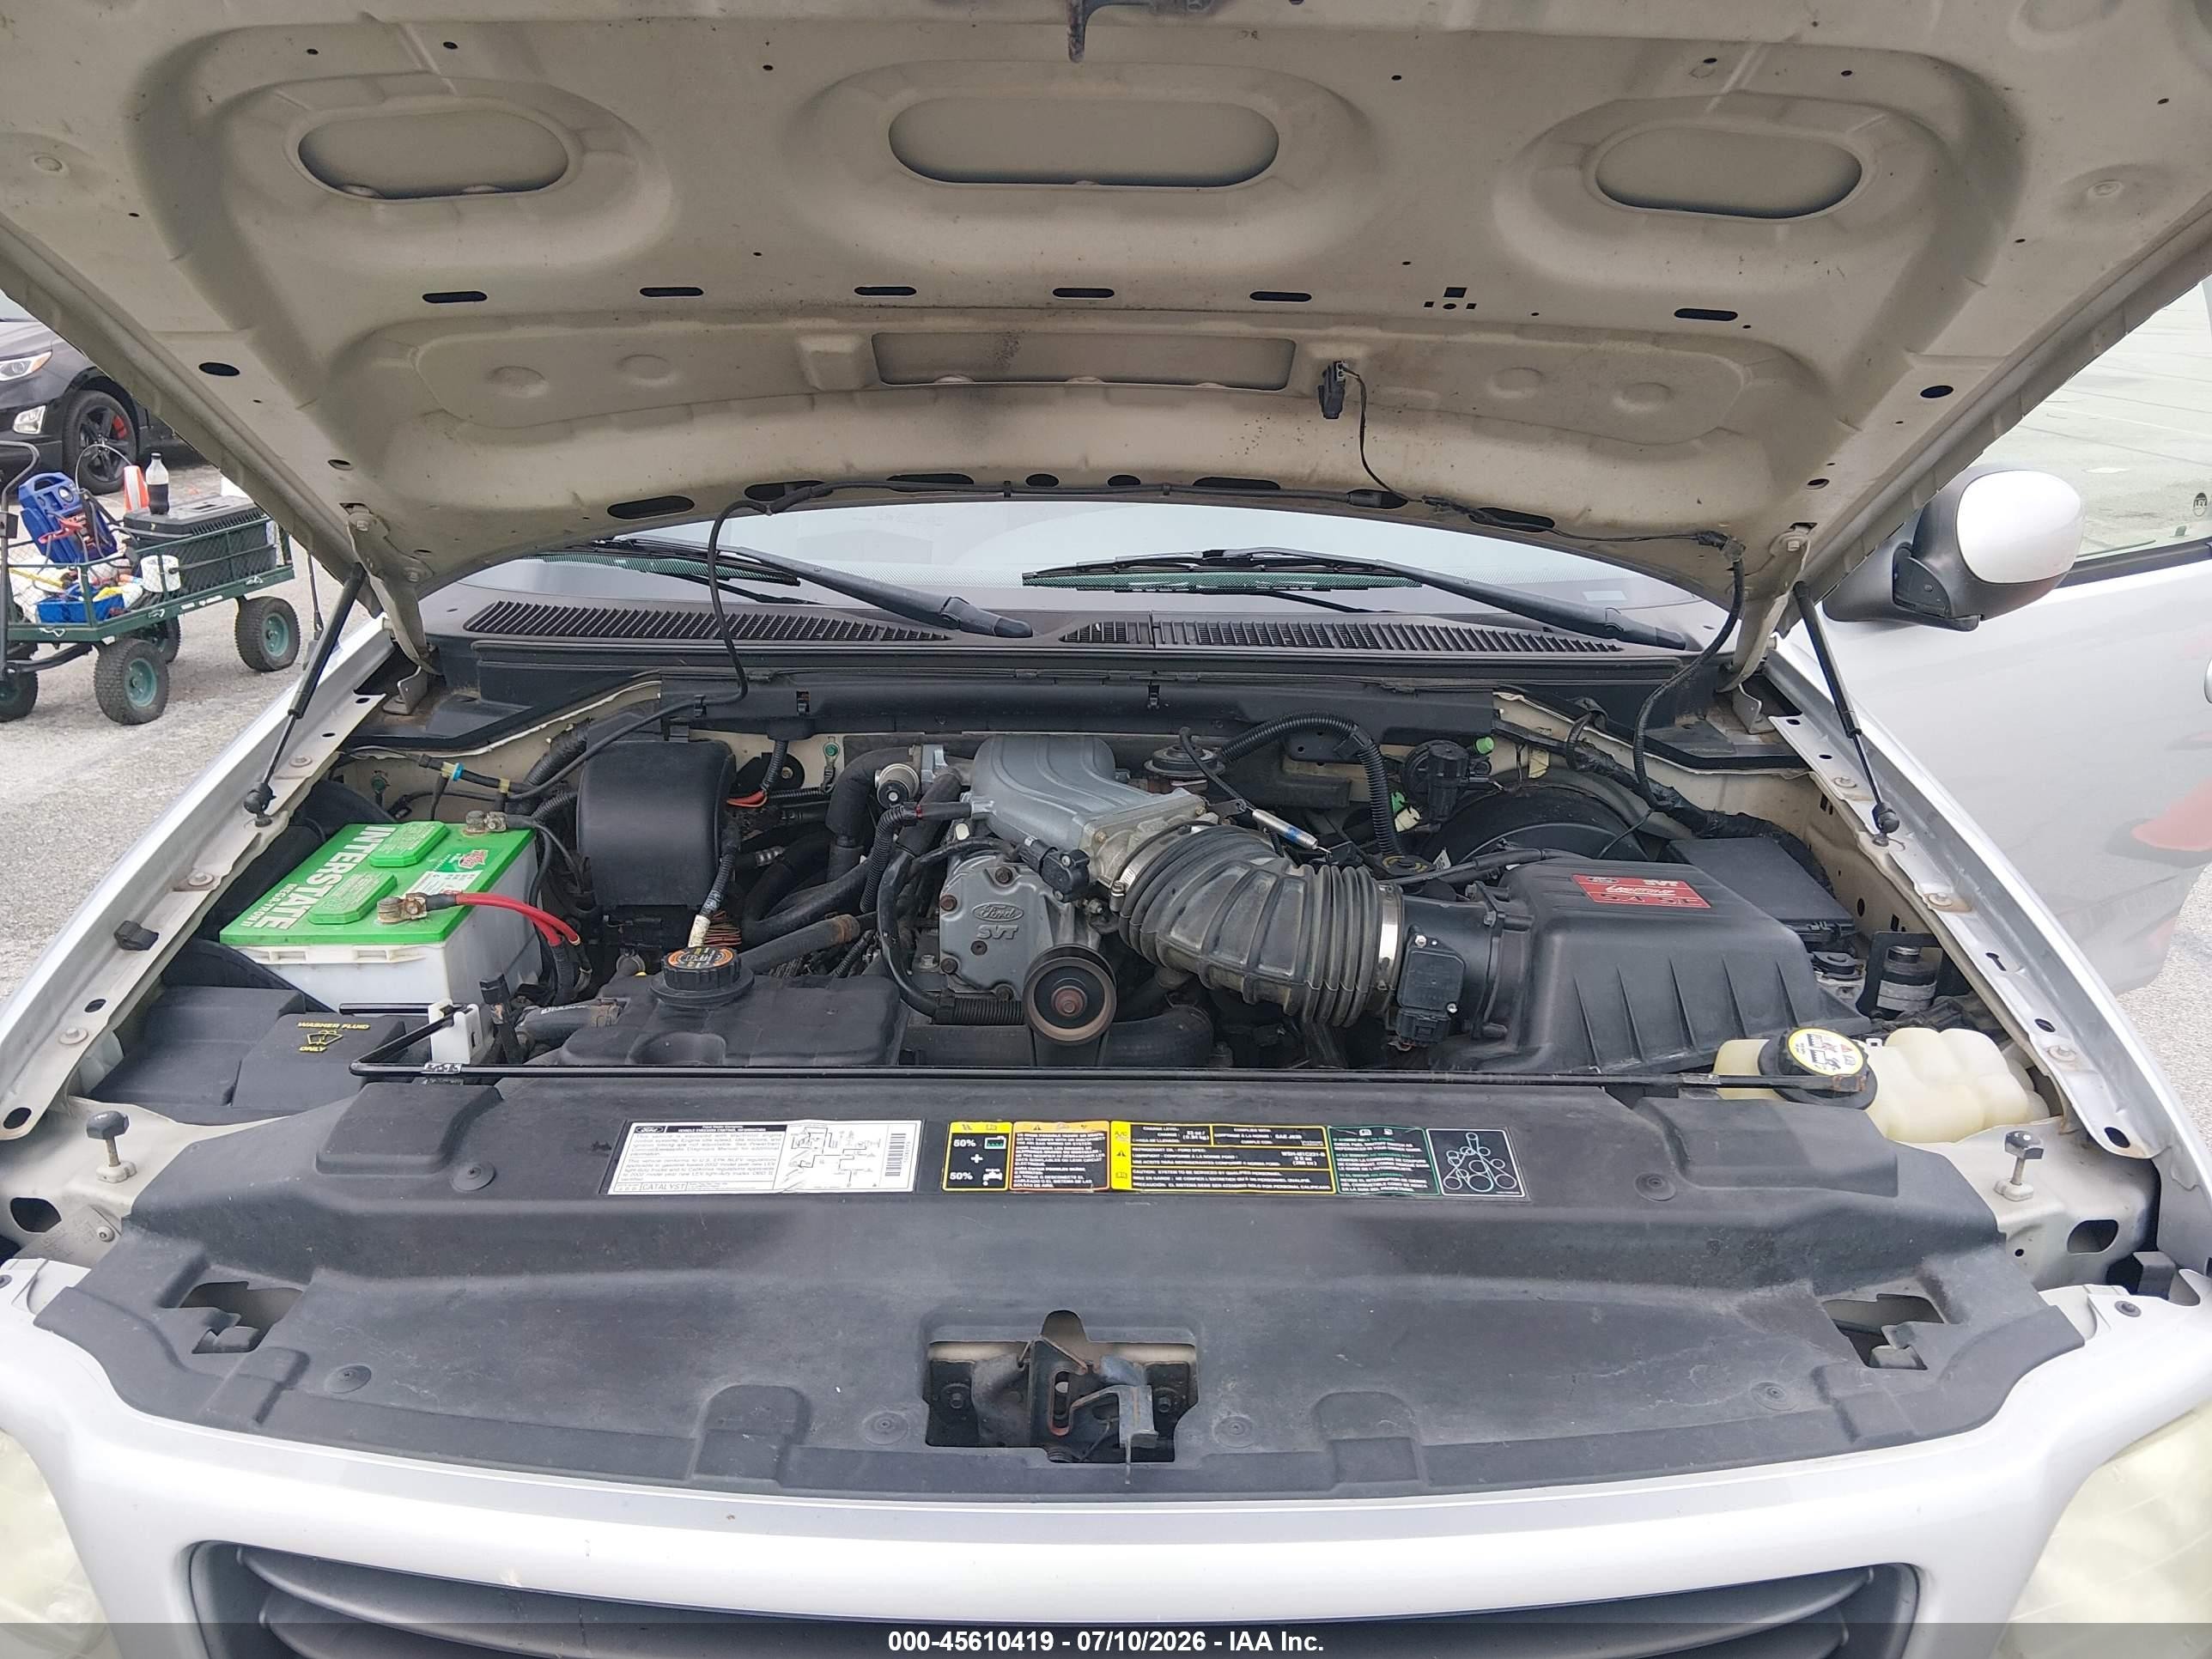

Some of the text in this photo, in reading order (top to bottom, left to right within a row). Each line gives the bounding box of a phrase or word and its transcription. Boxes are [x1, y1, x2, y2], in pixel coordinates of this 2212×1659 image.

[253, 826, 396, 930] INTERSTATE
[977, 904, 1018, 921] Ford
[977, 925, 1019, 940] SVT
[953, 1139, 976, 1147] 50%
[949, 1172, 974, 1181] 50%
